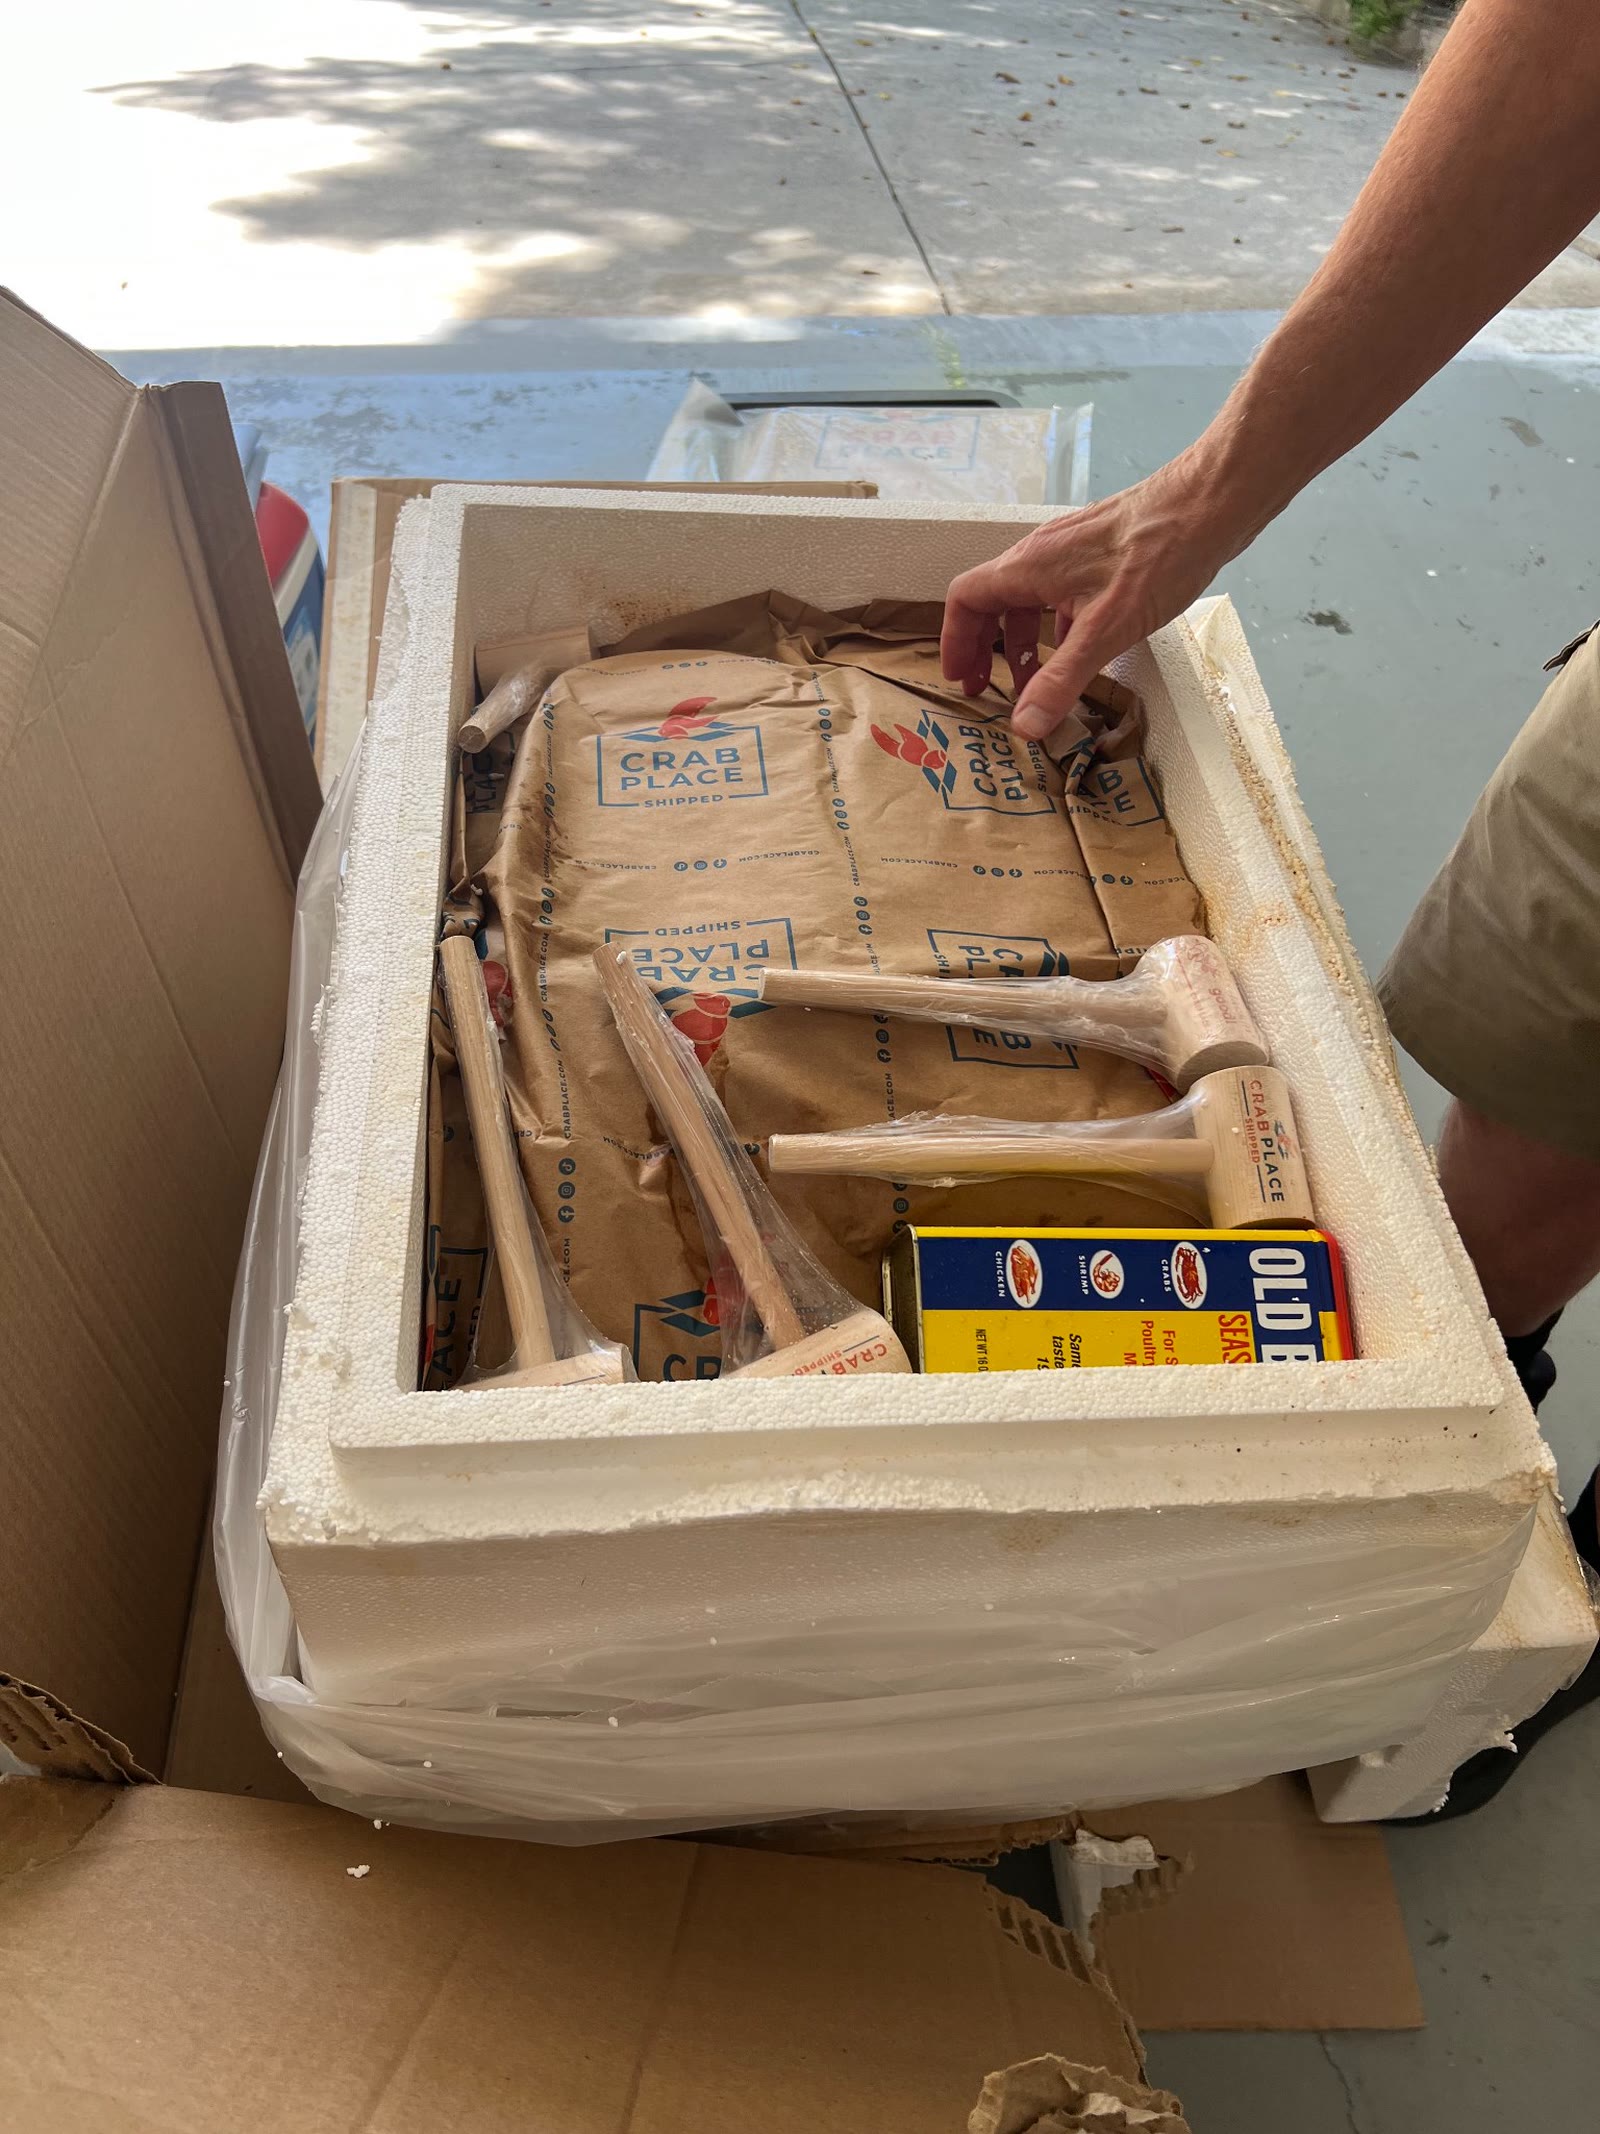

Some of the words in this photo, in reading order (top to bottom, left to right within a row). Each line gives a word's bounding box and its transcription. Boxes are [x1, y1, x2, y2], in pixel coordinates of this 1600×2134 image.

[620, 748, 741, 773] CRAB
[958, 725, 998, 797] CRAB
[987, 729, 1029, 801] PLACE
[1026, 740, 1047, 792] SHIPPED
[620, 767, 744, 791] PLACE
[644, 794, 724, 808] SHIPPED
[738, 849, 820, 863] CRABPLACE.COM
[880, 857, 958, 868] CRABPLACE.COM
[654, 920, 741, 937] SHIPPED
[631, 939, 770, 964] PLACE
[537, 931, 550, 1003] CRABPLACE.COM
[558, 1058, 573, 1139] CRABPLACE.COM
[1245, 1117, 1260, 1164] SHIPPED
[1249, 1080, 1270, 1132] CRAB
[1261, 1137, 1285, 1203] PLACE
[995, 1250, 1006, 1297] CHICKEN
[1078, 1255, 1089, 1295] SHRIMP
[1160, 1258, 1172, 1293] CRABS
[1249, 1247, 1313, 1331] OLD
[975, 1328, 987, 1342] NET
[977, 1343, 988, 1355] WT
[1162, 1329, 1176, 1354] For
[794, 1350, 842, 1375] SHIPPED
[831, 1343, 888, 1375] CRAB
[977, 1356, 988, 1365] 16
